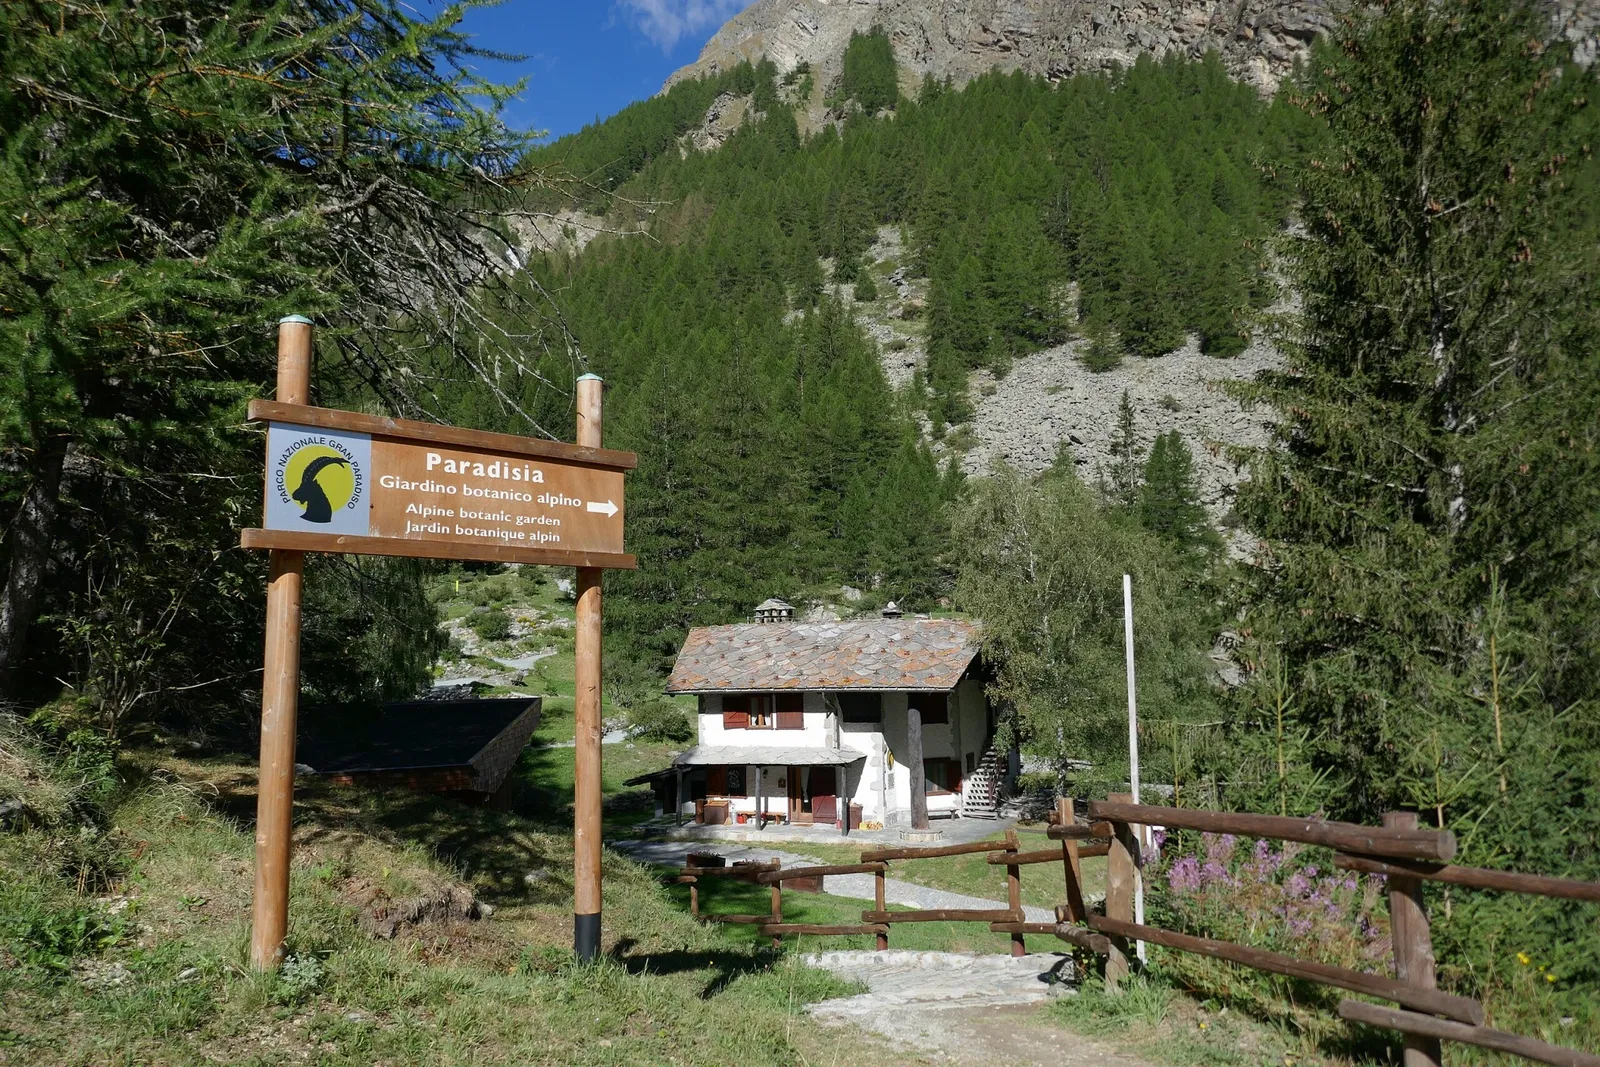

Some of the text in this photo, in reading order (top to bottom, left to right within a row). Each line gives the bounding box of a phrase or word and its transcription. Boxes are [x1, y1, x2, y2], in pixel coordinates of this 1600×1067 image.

[276, 437, 362, 509] PARCO NAZIONALE GRAN PARADISO
[426, 453, 545, 483] Paradisia
[380, 475, 582, 508] Giardino botanico alpino
[406, 503, 560, 527] Alpine botanic garden
[405, 520, 560, 543] Jardin botanique alpin
